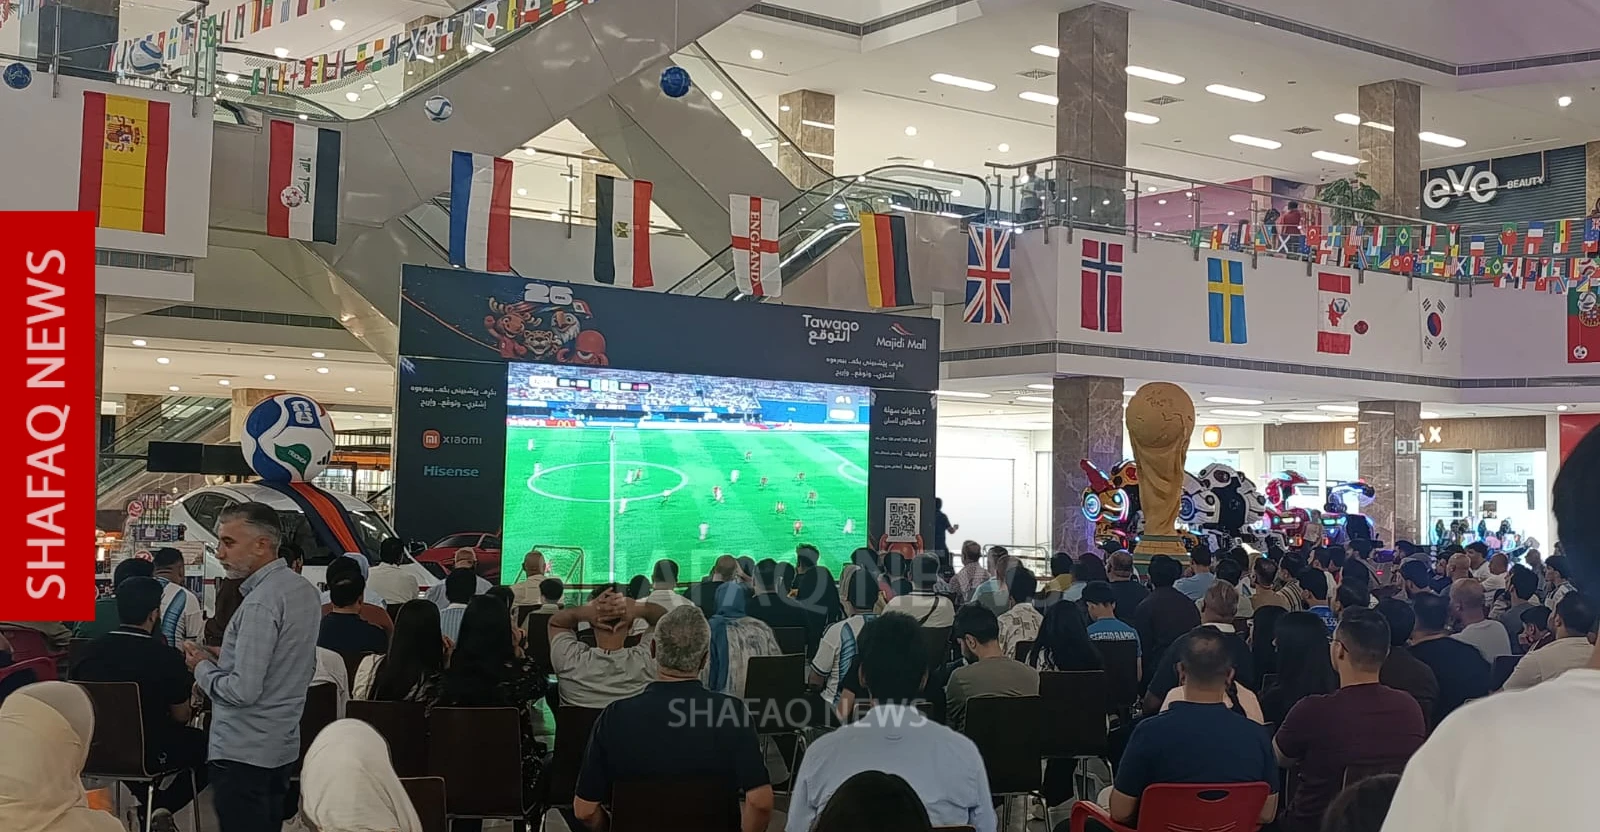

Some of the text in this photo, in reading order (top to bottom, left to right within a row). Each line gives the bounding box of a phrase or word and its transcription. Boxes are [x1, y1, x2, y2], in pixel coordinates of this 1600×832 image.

[1423, 165, 1545, 209] eve BEAUTY
[750, 211, 761, 287] ENGLAND
[802, 314, 860, 334] Tawaqo
[808, 328, 851, 345] التوقع
[876, 337, 927, 350] Majidi Mall
[442, 435, 483, 445] xiaomi
[423, 465, 480, 477] Hisense
